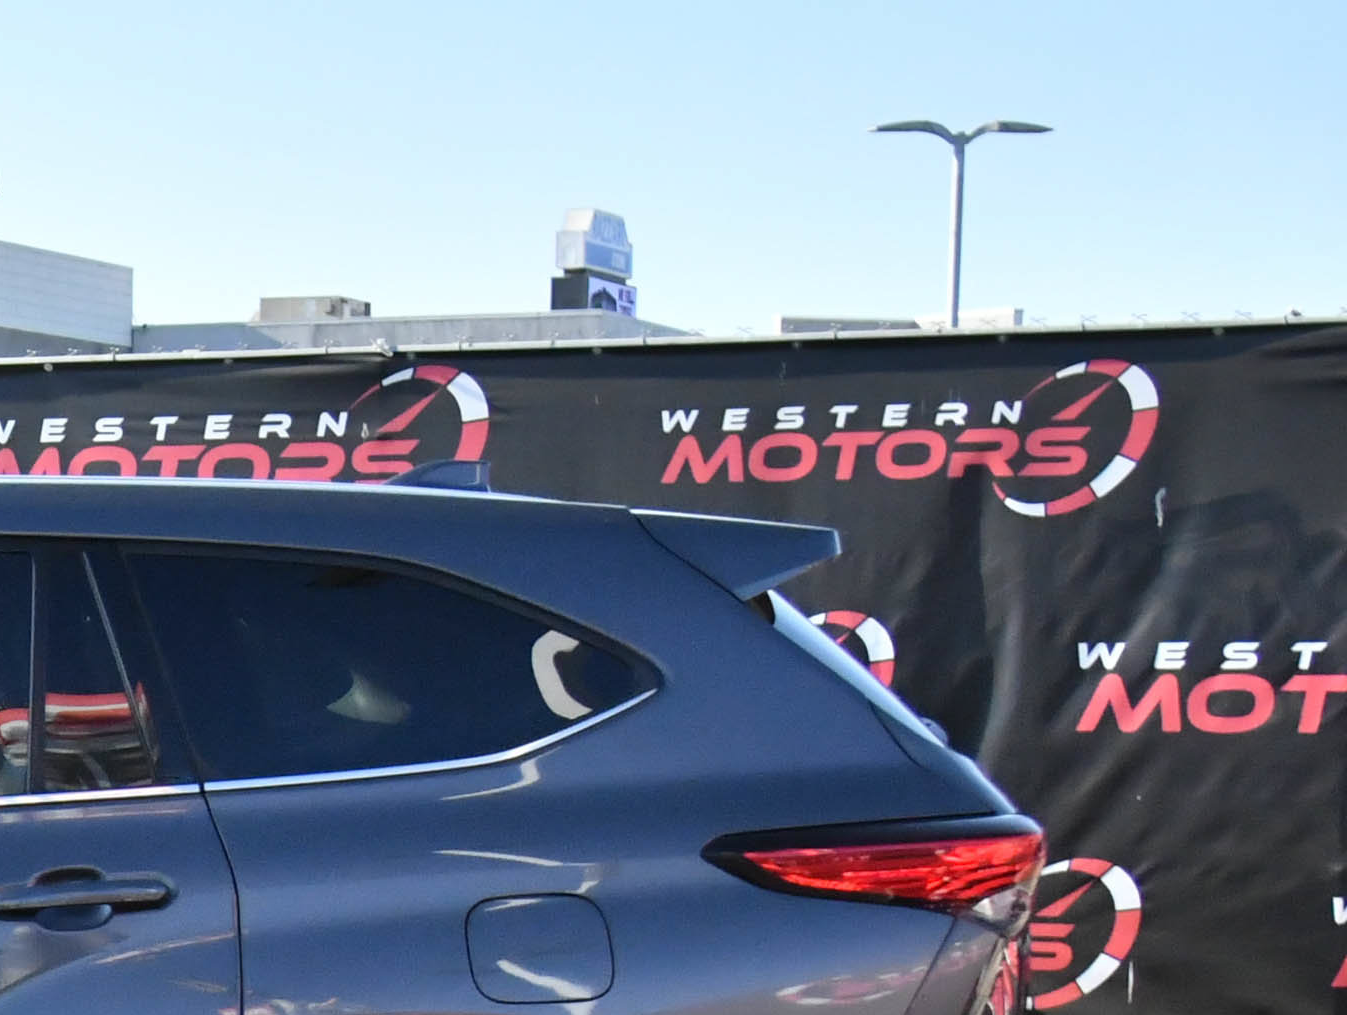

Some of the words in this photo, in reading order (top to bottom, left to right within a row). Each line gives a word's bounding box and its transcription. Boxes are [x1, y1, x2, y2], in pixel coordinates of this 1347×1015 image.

[662, 401, 1021, 432] WESTERN
[663, 427, 1090, 483] MOTORS
[1079, 642, 1327, 670] WEST
